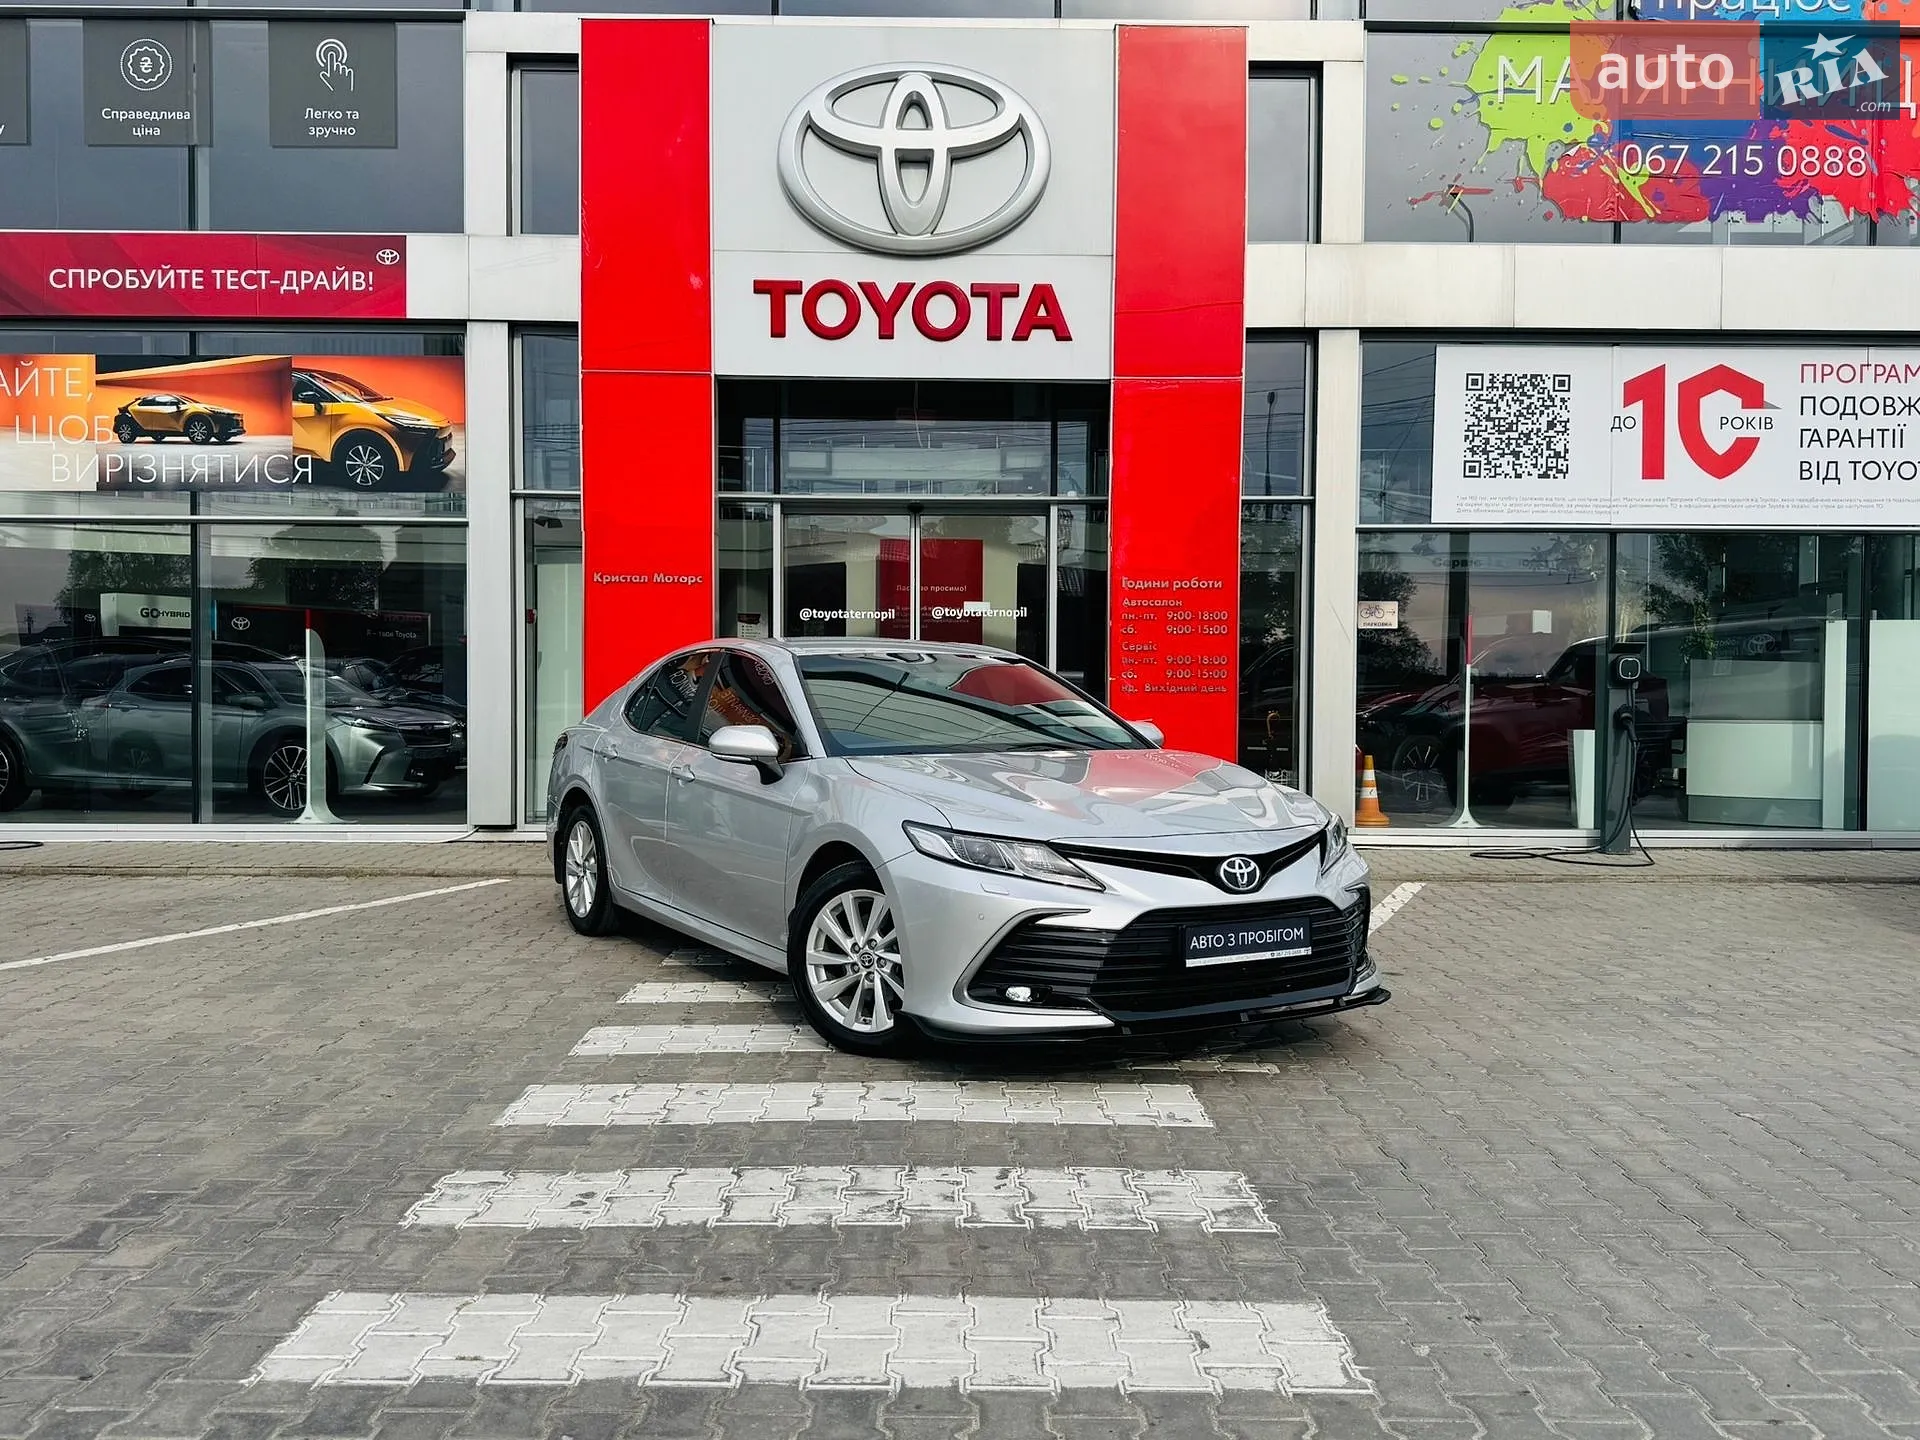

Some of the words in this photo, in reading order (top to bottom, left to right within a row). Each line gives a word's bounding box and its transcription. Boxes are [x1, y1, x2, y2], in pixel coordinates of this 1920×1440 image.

[101, 107, 191, 121] Справедлива
[304, 107, 343, 119] Легко
[346, 109, 360, 119] та
[132, 124, 161, 137] ціна
[308, 126, 356, 138] зручно
[1621, 144, 1689, 175] 067
[1702, 145, 1764, 175] 215
[1776, 145, 1868, 177] 0888
[48, 264, 204, 290] СПРОБУЙТЕ
[211, 265, 374, 295] ТЕСТ-ДРАЙВ!
[753, 278, 1073, 342] TOYOTA
[1799, 395, 1920, 420] ПОДОВЖ
[1610, 415, 1637, 432] ДО
[1719, 416, 1774, 430] РОКІВ
[15, 414, 114, 449] ЩОБ
[1799, 423, 1907, 448] ГАРАНТІЇ
[51, 454, 312, 484] ВИРІЗНЯТИСЯ
[1799, 460, 1841, 484] ВІД
[1849, 460, 1920, 481] TOYO
[593, 571, 648, 584] Кристал
[653, 572, 703, 585] Моторс
[1121, 576, 1169, 589] Години
[1173, 576, 1223, 591] роботи
[930, 584, 967, 594] просимо!
[1122, 598, 1182, 607] Автосалон
[799, 607, 896, 621] @toyotaternopil
[931, 606, 1028, 620] @toyotaternopil
[1121, 624, 1137, 634] сб.
[1121, 641, 1158, 653] Сервіс
[1121, 669, 1138, 678] сб.
[1121, 684, 1138, 693] нд.
[1144, 682, 1198, 693] Вихідний
[1200, 684, 1227, 692] день
[1190, 934, 1225, 950] АВТО
[1227, 933, 1236, 946] З
[1238, 927, 1304, 945] ПРОБІГОМ
